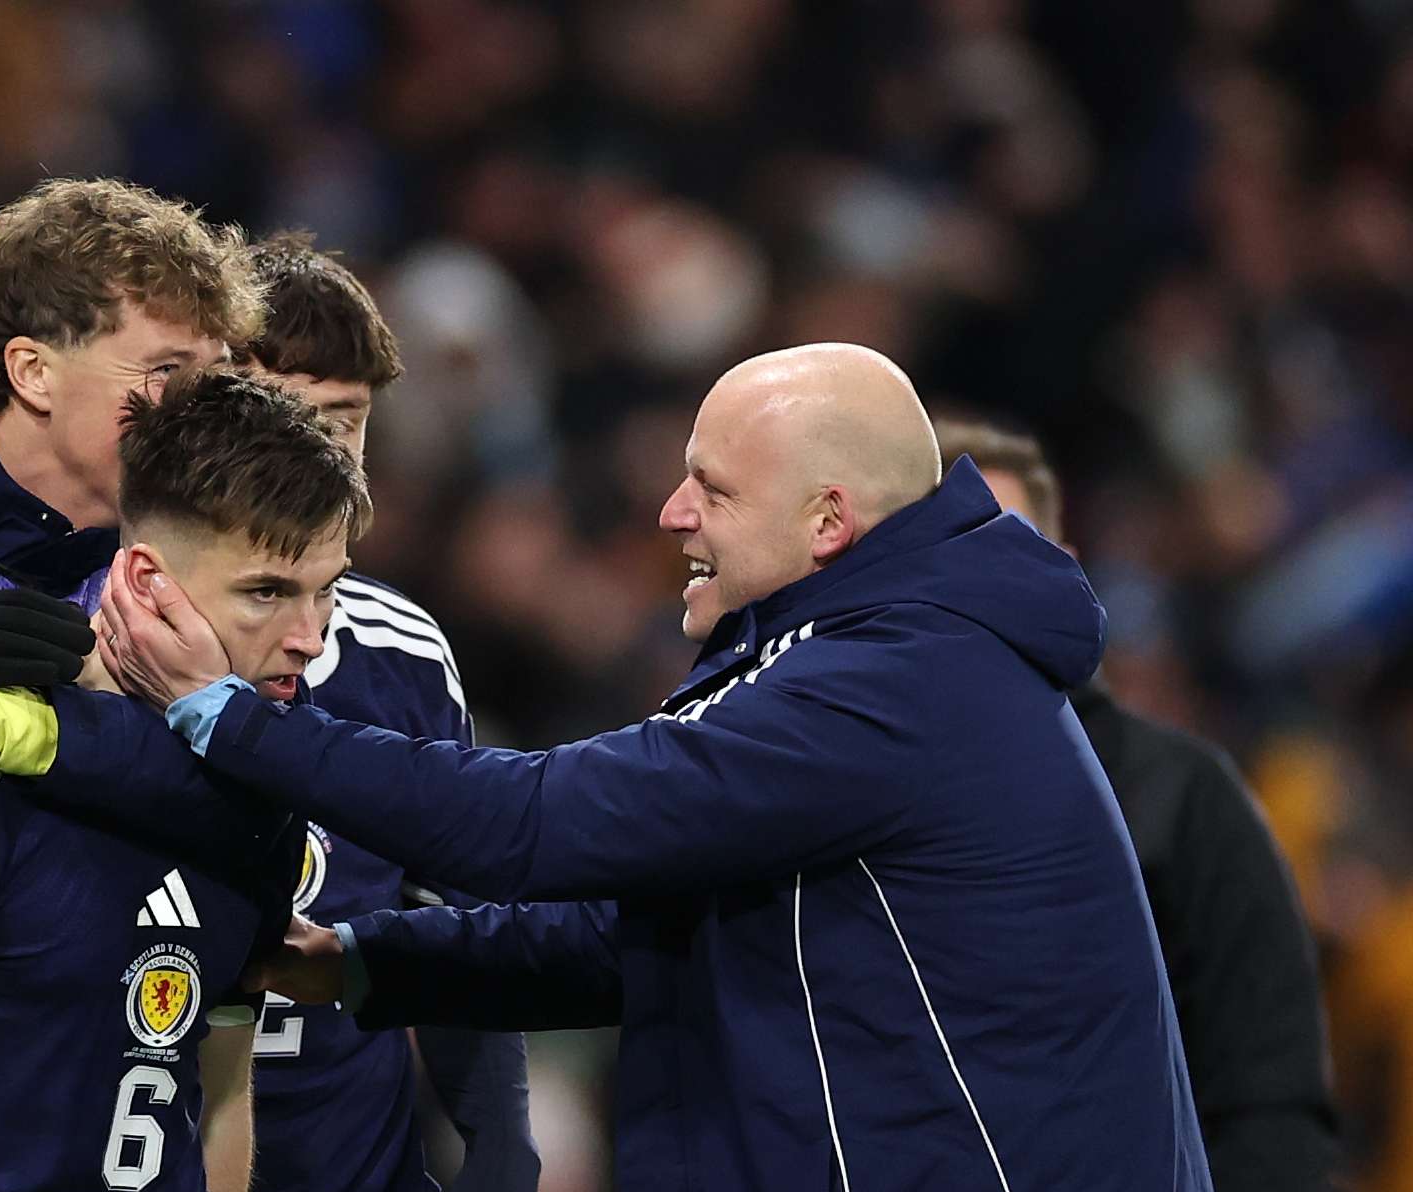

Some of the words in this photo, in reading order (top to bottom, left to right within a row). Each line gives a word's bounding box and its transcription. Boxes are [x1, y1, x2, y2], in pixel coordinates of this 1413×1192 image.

[129, 943, 166, 972] SCOTLAND
[167, 943, 174, 952] V
[149, 957, 187, 969] SCOTLAND
[101, 1065, 178, 1192] 6
